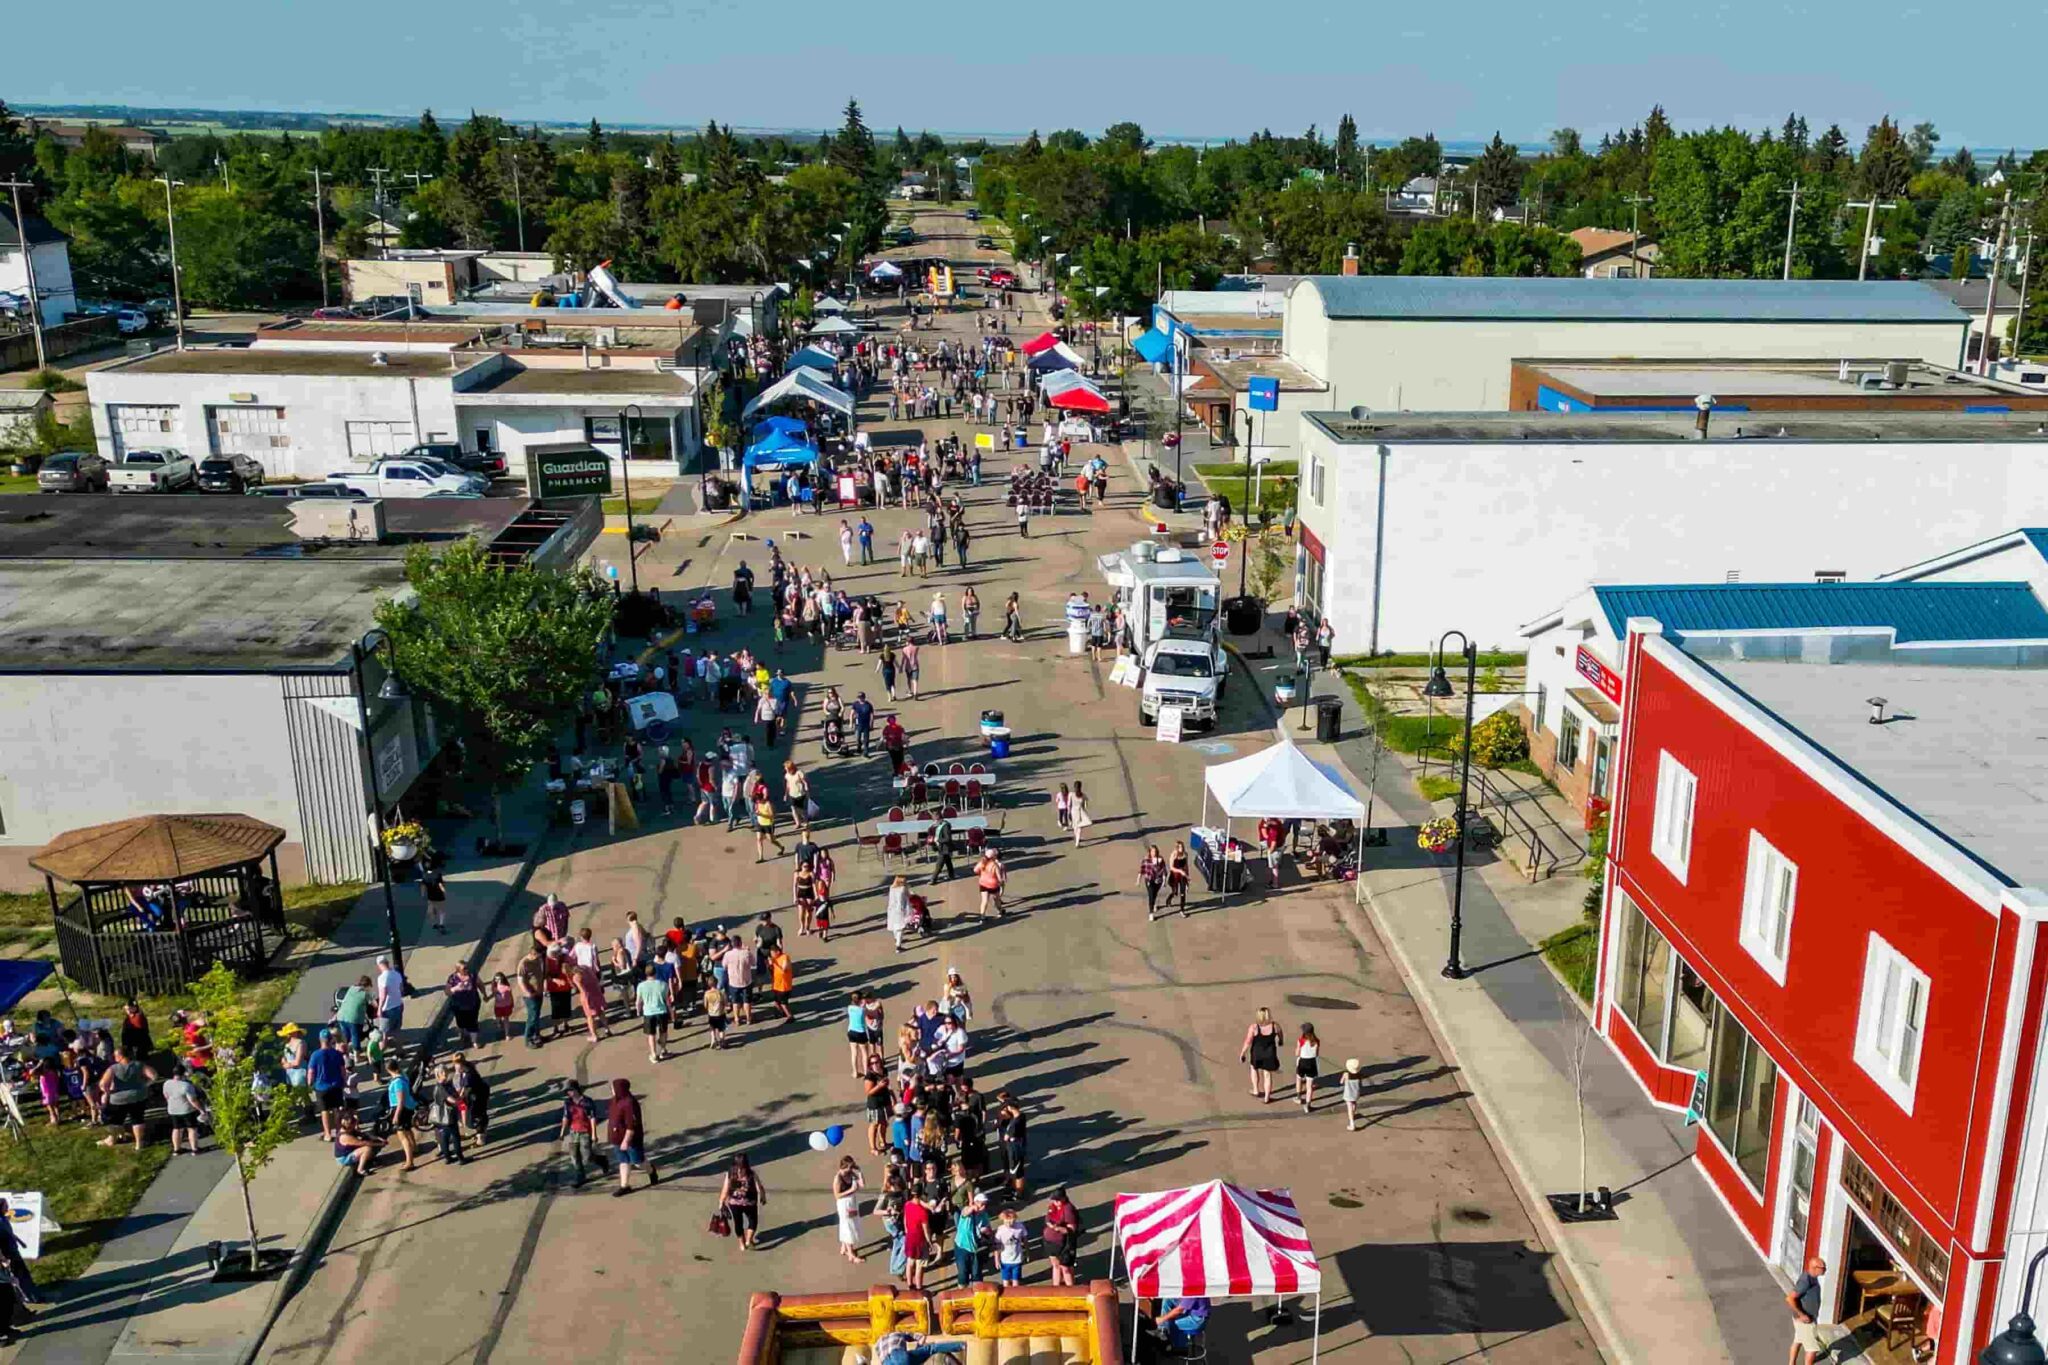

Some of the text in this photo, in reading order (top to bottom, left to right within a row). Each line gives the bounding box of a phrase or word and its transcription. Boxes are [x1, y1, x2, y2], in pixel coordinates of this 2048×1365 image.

[543, 461, 605, 474] Guardian
[548, 477, 603, 487] PHARMACY
[1212, 546, 1229, 555] STOP
